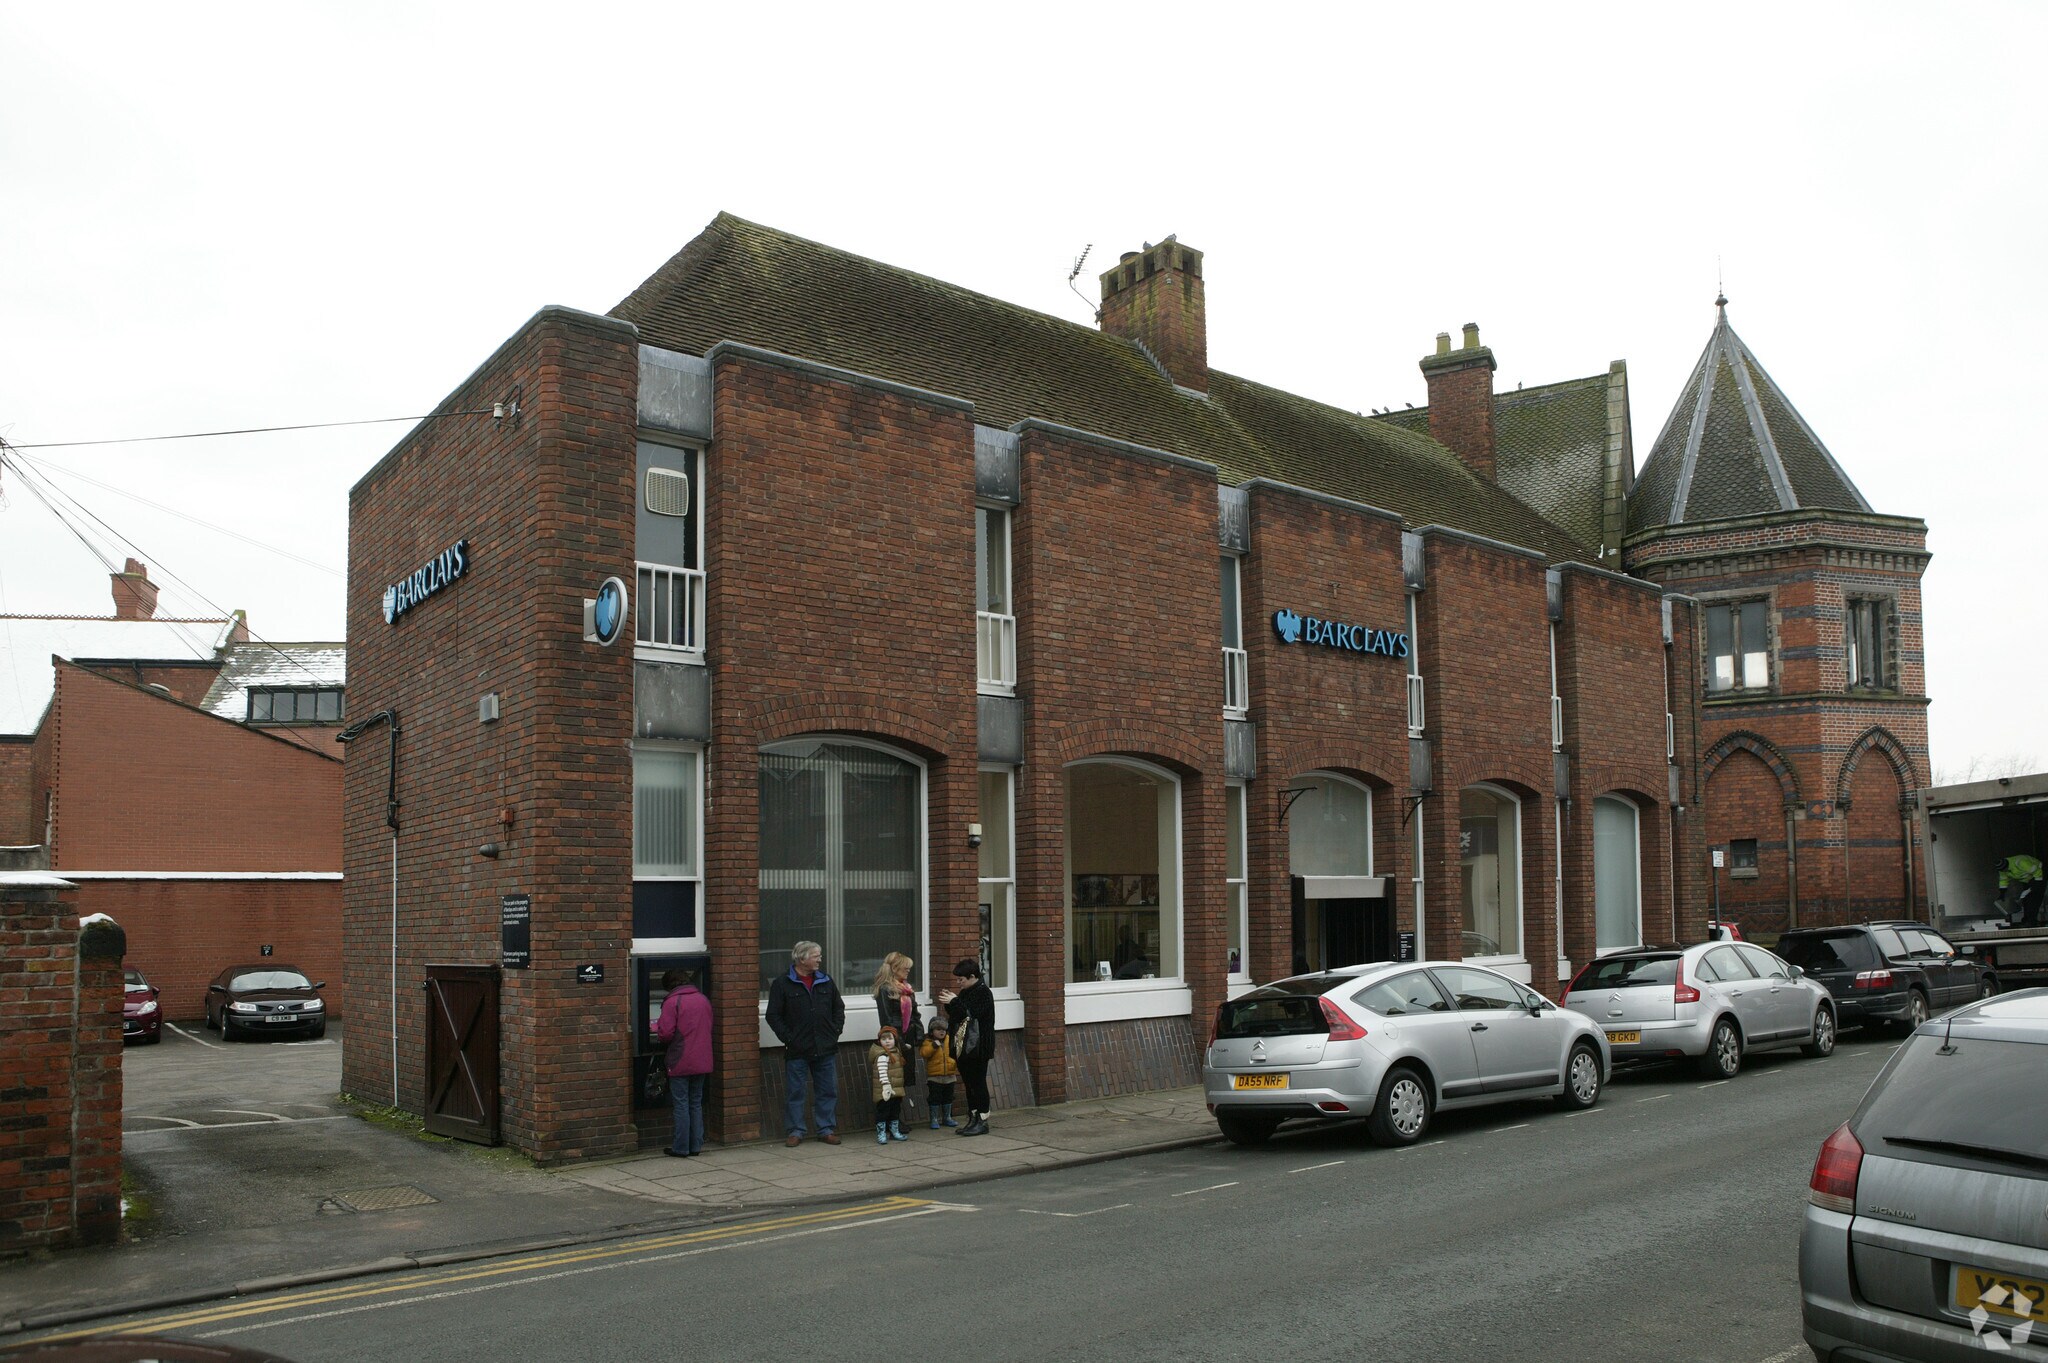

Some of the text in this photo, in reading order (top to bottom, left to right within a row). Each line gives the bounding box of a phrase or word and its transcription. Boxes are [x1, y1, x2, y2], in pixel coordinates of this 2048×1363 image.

[397, 539, 466, 615] BARCLAYS
[1305, 616, 1409, 658] BARCLAYS
[1618, 1032, 1636, 1042] GKD
[1238, 1075, 1283, 1087] DA55 NRF
[1868, 1204, 1917, 1221] SIGNUM
